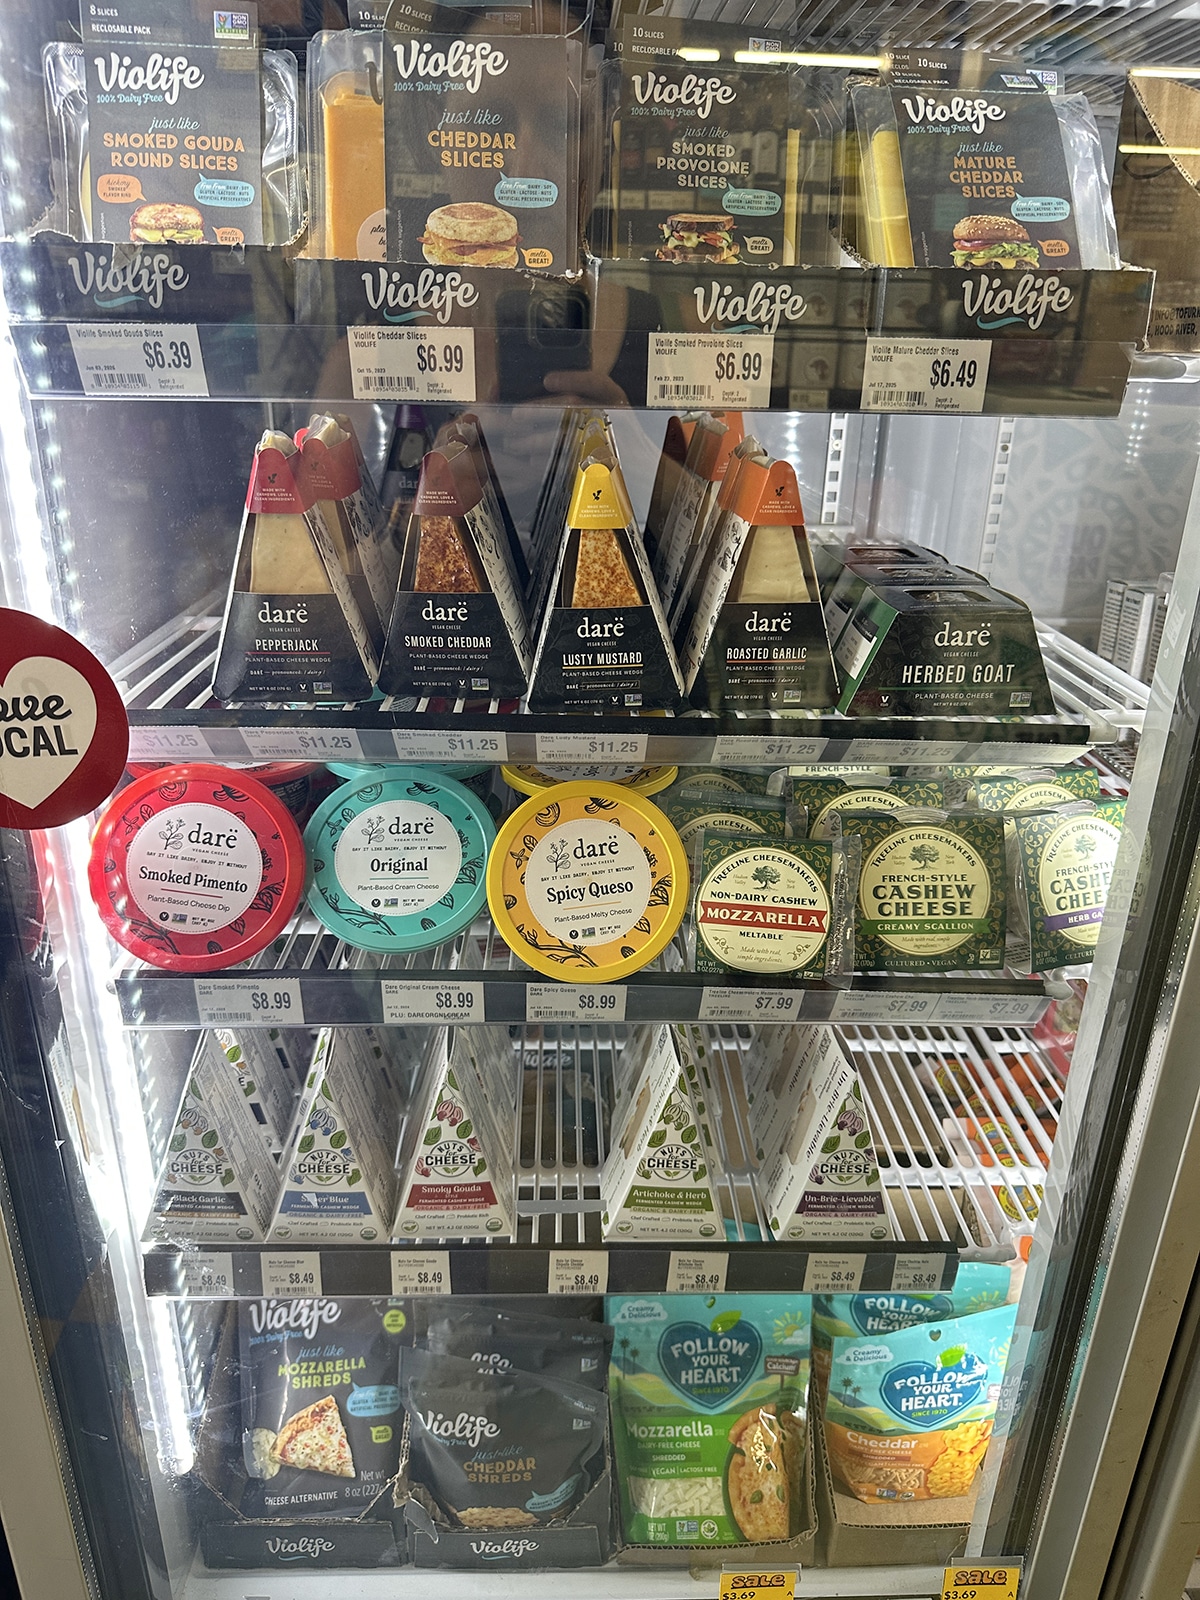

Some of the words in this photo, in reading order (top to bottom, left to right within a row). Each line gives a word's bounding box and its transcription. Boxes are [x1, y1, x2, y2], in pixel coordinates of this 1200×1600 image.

[90, 5, 96, 16] 8
[97, 8, 118, 17] SLICES
[91, 24, 132, 34] RECLOSABLE
[133, 26, 151, 35] PACK
[393, 40, 509, 94] Violife
[94, 52, 205, 105] Violife
[394, 81, 414, 92] 100%
[416, 81, 442, 94] Dairy
[443, 81, 465, 91] Free
[632, 72, 737, 119] Violife
[438, 109, 472, 130] just
[475, 108, 503, 126] like
[901, 96, 1006, 134] Violife
[148, 117, 176, 133] just
[177, 117, 200, 131] like
[103, 132, 178, 149] SMOKED
[183, 135, 245, 152] GOUDA
[427, 130, 516, 149] CHEDDAR
[672, 142, 735, 158] SMOKED
[111, 152, 174, 168] ROUND
[179, 154, 239, 171] SLICES
[441, 151, 505, 169] SLICES
[656, 157, 749, 175] PROVOLONE
[953, 156, 1016, 169] MATURE
[677, 175, 728, 189] SLICES
[949, 170, 1024, 184] CHEDDAR
[962, 185, 1016, 199] SLICES
[68, 251, 190, 309] Violife
[362, 267, 480, 325] Violife
[962, 274, 1074, 330] Violife
[693, 281, 807, 333] Violife
[76, 329, 96, 338] Violife
[98, 329, 122, 338] Smoked
[123, 329, 143, 338] Gouda
[144, 329, 164, 338] Slices
[353, 332, 376, 340] Violife
[377, 332, 405, 340] Cheddar
[407, 332, 427, 340] Slices
[1154, 325, 1174, 336] HOOD
[1176, 323, 1198, 336] RIVER,
[143, 340, 192, 371] $6.39
[417, 344, 464, 375] $6.99
[715, 352, 762, 382] $6.99
[930, 359, 977, 389] $6.49
[258, 602, 308, 624] darë
[421, 600, 469, 622] darë
[576, 617, 625, 639] darë
[744, 611, 792, 633] darë
[404, 635, 444, 648] SMOKED
[447, 636, 492, 649] CHEDDAR
[934, 622, 992, 648] darë
[255, 639, 319, 651] PEPPERJACK
[563, 653, 594, 666] LUSTY
[596, 652, 642, 665] MUSTARD
[726, 647, 768, 660] ROASTED
[772, 647, 808, 660] GARLIC
[902, 665, 966, 684] HERBED
[972, 664, 1015, 683] GOAT
[298, 736, 353, 750] $11.25
[448, 738, 499, 751] $11.25
[588, 741, 639, 754] $11.25
[388, 816, 434, 835] darë
[188, 823, 238, 850] darë
[573, 835, 619, 860] darë
[870, 837, 907, 868] TREELINE
[909, 833, 977, 868] CHEESEMAKERS
[226, 862, 248, 870] WITHOUT
[370, 857, 428, 875] Original
[711, 857, 750, 886] TREELINE
[753, 854, 819, 894] CHEESEMAKERS
[139, 866, 191, 885] Smoked
[193, 873, 248, 893] Pimento
[882, 874, 967, 883] FRENCH-STYLE
[357, 884, 394, 892] Plant-Based
[546, 885, 586, 905] Spicy
[589, 880, 634, 898] Queso
[872, 884, 976, 900] CASHEW
[147, 894, 189, 907] Plant-Based
[190, 900, 217, 910] Cheese
[217, 904, 231, 913] Dip
[710, 891, 768, 903] NON-DAIRY
[771, 896, 819, 906] CASHEW
[554, 912, 590, 923] Plant-Based
[590, 909, 609, 919] Melty
[609, 907, 633, 916] Cheese
[707, 907, 820, 927] MOZZARELLA
[877, 901, 973, 917] CHEESE
[1068, 913, 1089, 923] HERB
[877, 922, 920, 931] CREAMY
[924, 922, 974, 931] SCALLION
[739, 931, 784, 941] MELTABLE
[885, 960, 926, 968] CULTURED
[251, 992, 292, 1011] $8.99
[436, 992, 474, 1009] $8.99
[578, 994, 616, 1010] $8.99
[755, 997, 793, 1010] $7.99
[887, 1000, 928, 1013] $7.99
[437, 1142, 465, 1153] NUTS
[660, 1146, 687, 1157] NUTS
[425, 1153, 477, 1166] CHEESE
[647, 1158, 698, 1170] CHEESE
[820, 1163, 871, 1175] CHEESE
[422, 1185, 451, 1194] Smoky
[453, 1184, 482, 1193] Gouda
[633, 1189, 675, 1199] Artichoke
[677, 1191, 684, 1199] &
[173, 1194, 198, 1203] Black
[199, 1194, 226, 1203] Garlic
[329, 1195, 350, 1203] Blue
[804, 1194, 878, 1203] Un-Brie-Lievable
[289, 1272, 314, 1284] $8.49
[418, 1272, 443, 1284] $8.49
[574, 1274, 599, 1286] $8.49
[671, 1337, 750, 1359] FOLLOW
[853, 1349, 882, 1357] Creamy
[691, 1354, 730, 1367] YOUR
[853, 1354, 887, 1362] Delicious
[278, 1357, 367, 1377] MOZZARELLA
[292, 1372, 352, 1389] SHREDS
[680, 1366, 742, 1385] HEART
[913, 1383, 952, 1395] YOUR
[626, 1421, 713, 1438] Mozzarella
[847, 1432, 919, 1449] Cheddar
[463, 1457, 537, 1474] CHEDDAR
[652, 1454, 686, 1462] SHREDDED
[361, 1471, 375, 1481] Net
[375, 1470, 385, 1480] wt
[468, 1473, 533, 1484] SHREDS
[651, 1467, 676, 1476] VEGAN
[265, 1494, 289, 1506] CHEESE
[291, 1491, 338, 1504] ALTERNATIVE
[265, 1537, 336, 1557] Violife
[470, 1540, 539, 1557] Violife
[731, 1575, 785, 1587] sale
[954, 1570, 1008, 1586] sale
